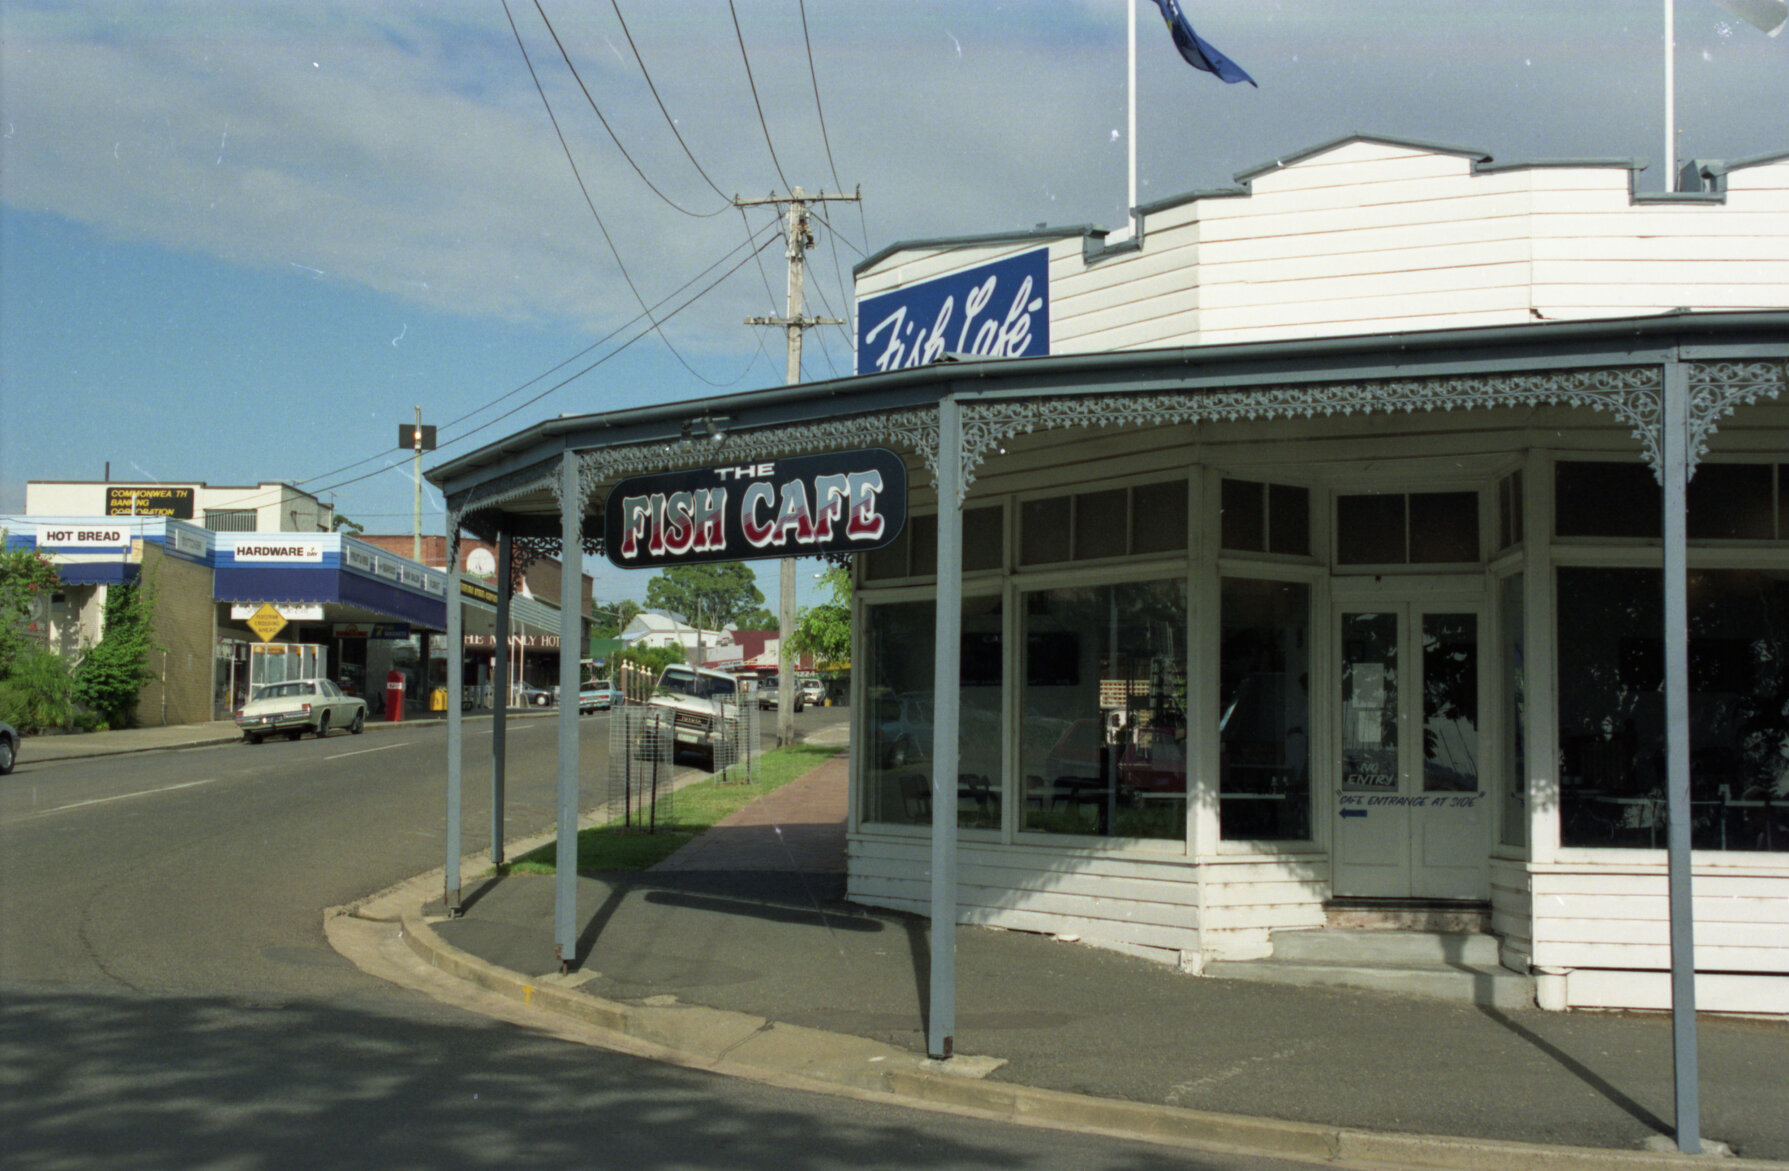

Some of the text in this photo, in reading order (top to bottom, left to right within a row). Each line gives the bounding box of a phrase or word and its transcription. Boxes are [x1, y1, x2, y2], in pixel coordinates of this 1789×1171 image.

[866, 275, 1043, 372] Fish Café
[714, 463, 776, 481] THE
[111, 489, 188, 498] COMMONWEATH
[110, 499, 150, 507] BANKNG
[110, 508, 175, 516] CORORATION
[621, 469, 885, 559] FISH CAFE
[47, 531, 121, 541] HOT BREAD
[236, 546, 304, 557] HARDWARE
[464, 634, 484, 644] HE
[489, 635, 537, 646] MNLY
[1360, 762, 1379, 773] NO
[1347, 774, 1394, 785] ENTRY
[1367, 796, 1430, 807] ENTRANCE
[1432, 796, 1448, 807] AT
